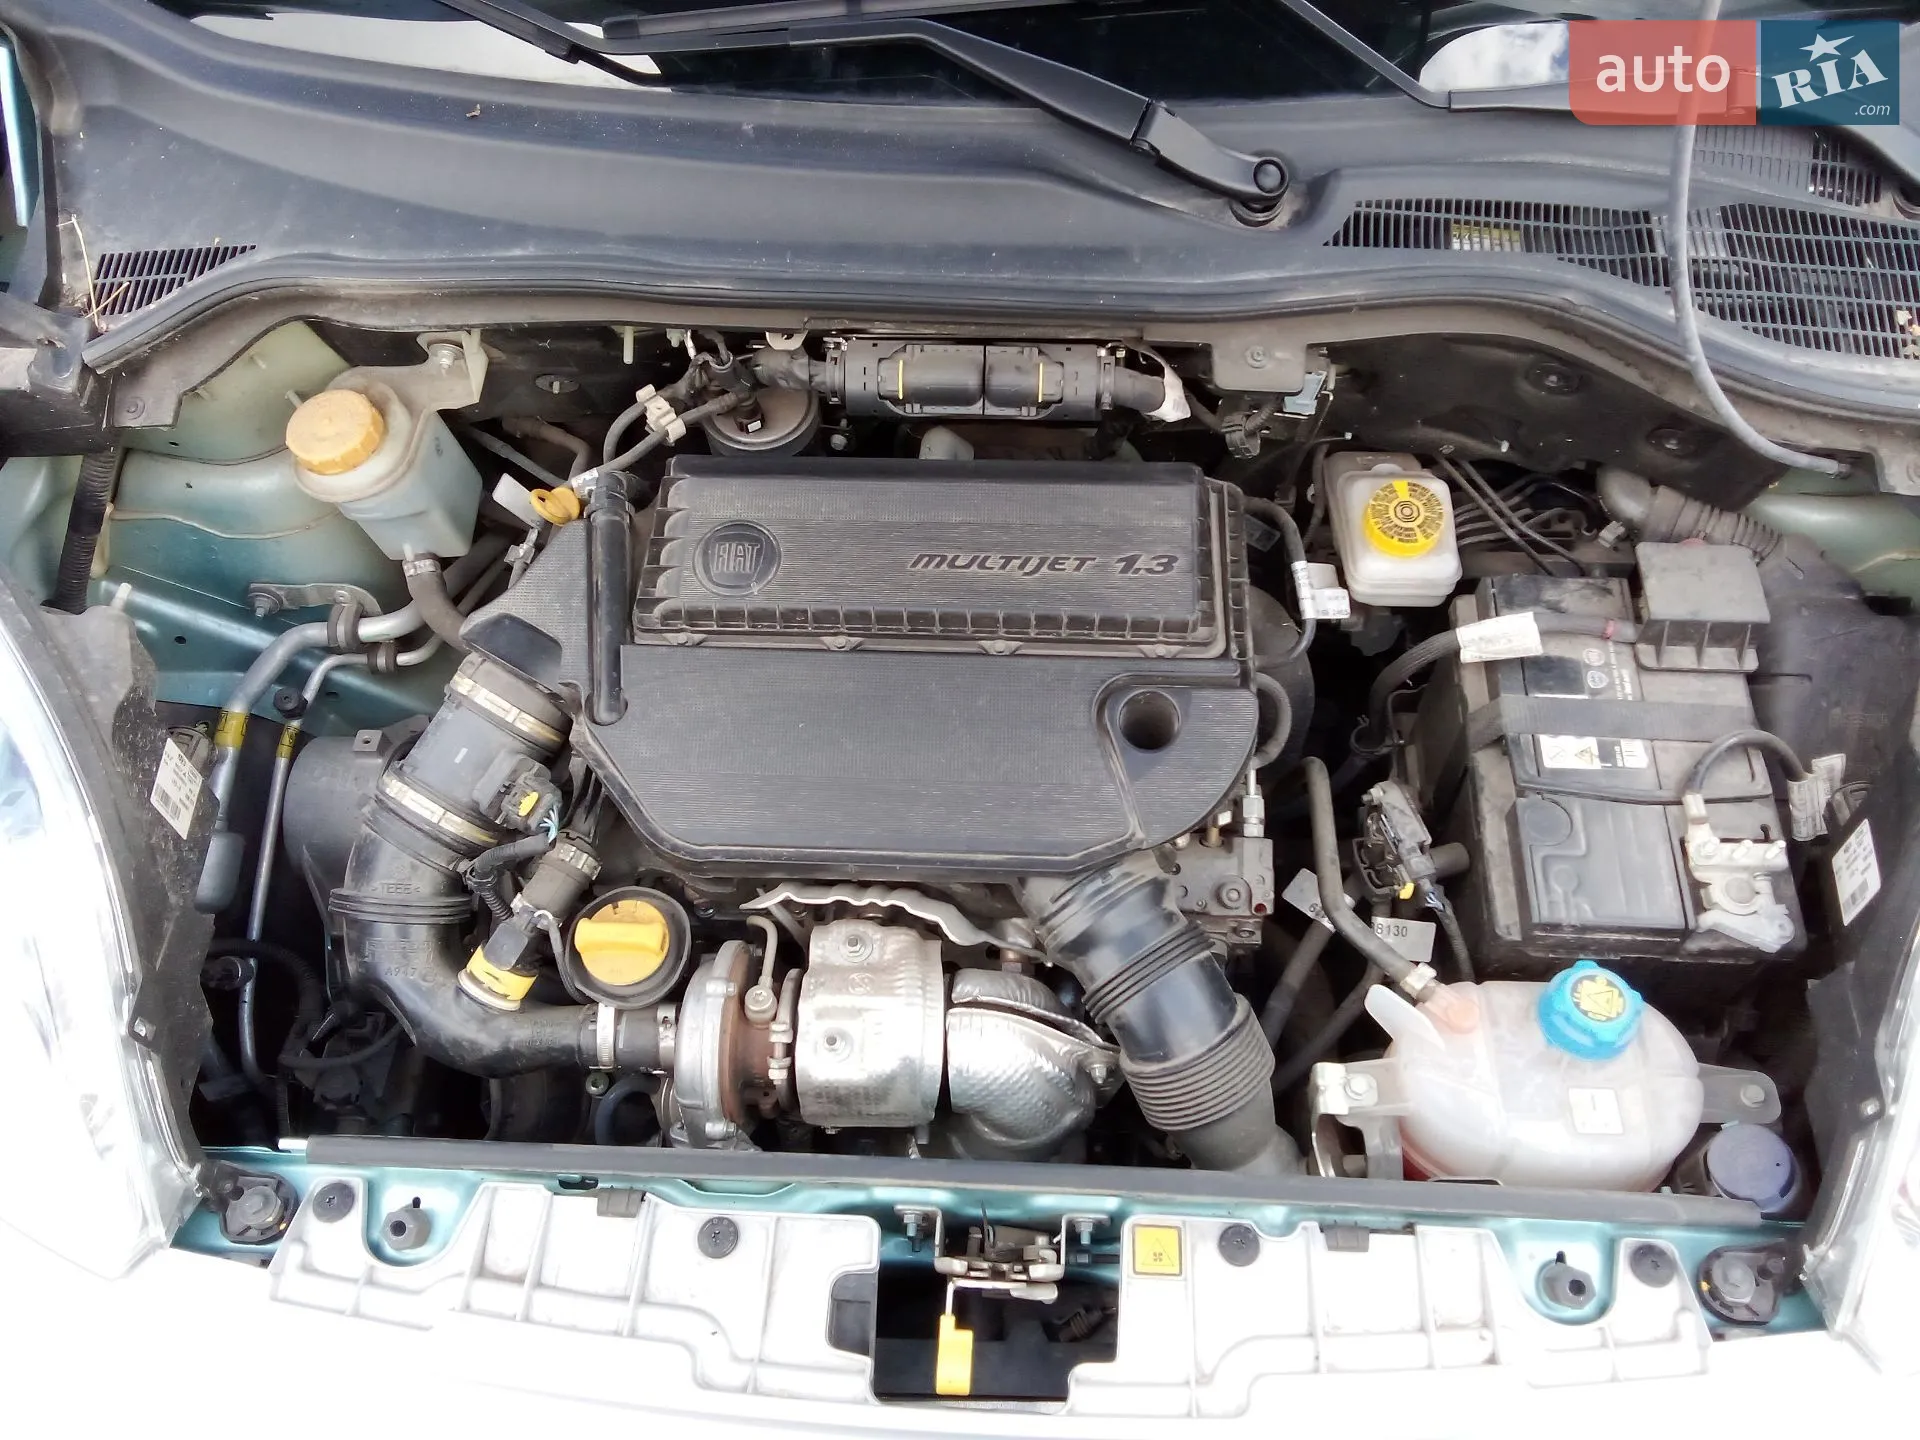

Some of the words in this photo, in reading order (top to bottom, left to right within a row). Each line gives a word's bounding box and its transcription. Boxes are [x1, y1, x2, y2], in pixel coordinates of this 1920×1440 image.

[713, 542, 760, 573] FIAT
[908, 553, 1097, 577] MULTIJET
[1114, 553, 1179, 575] 1.3
